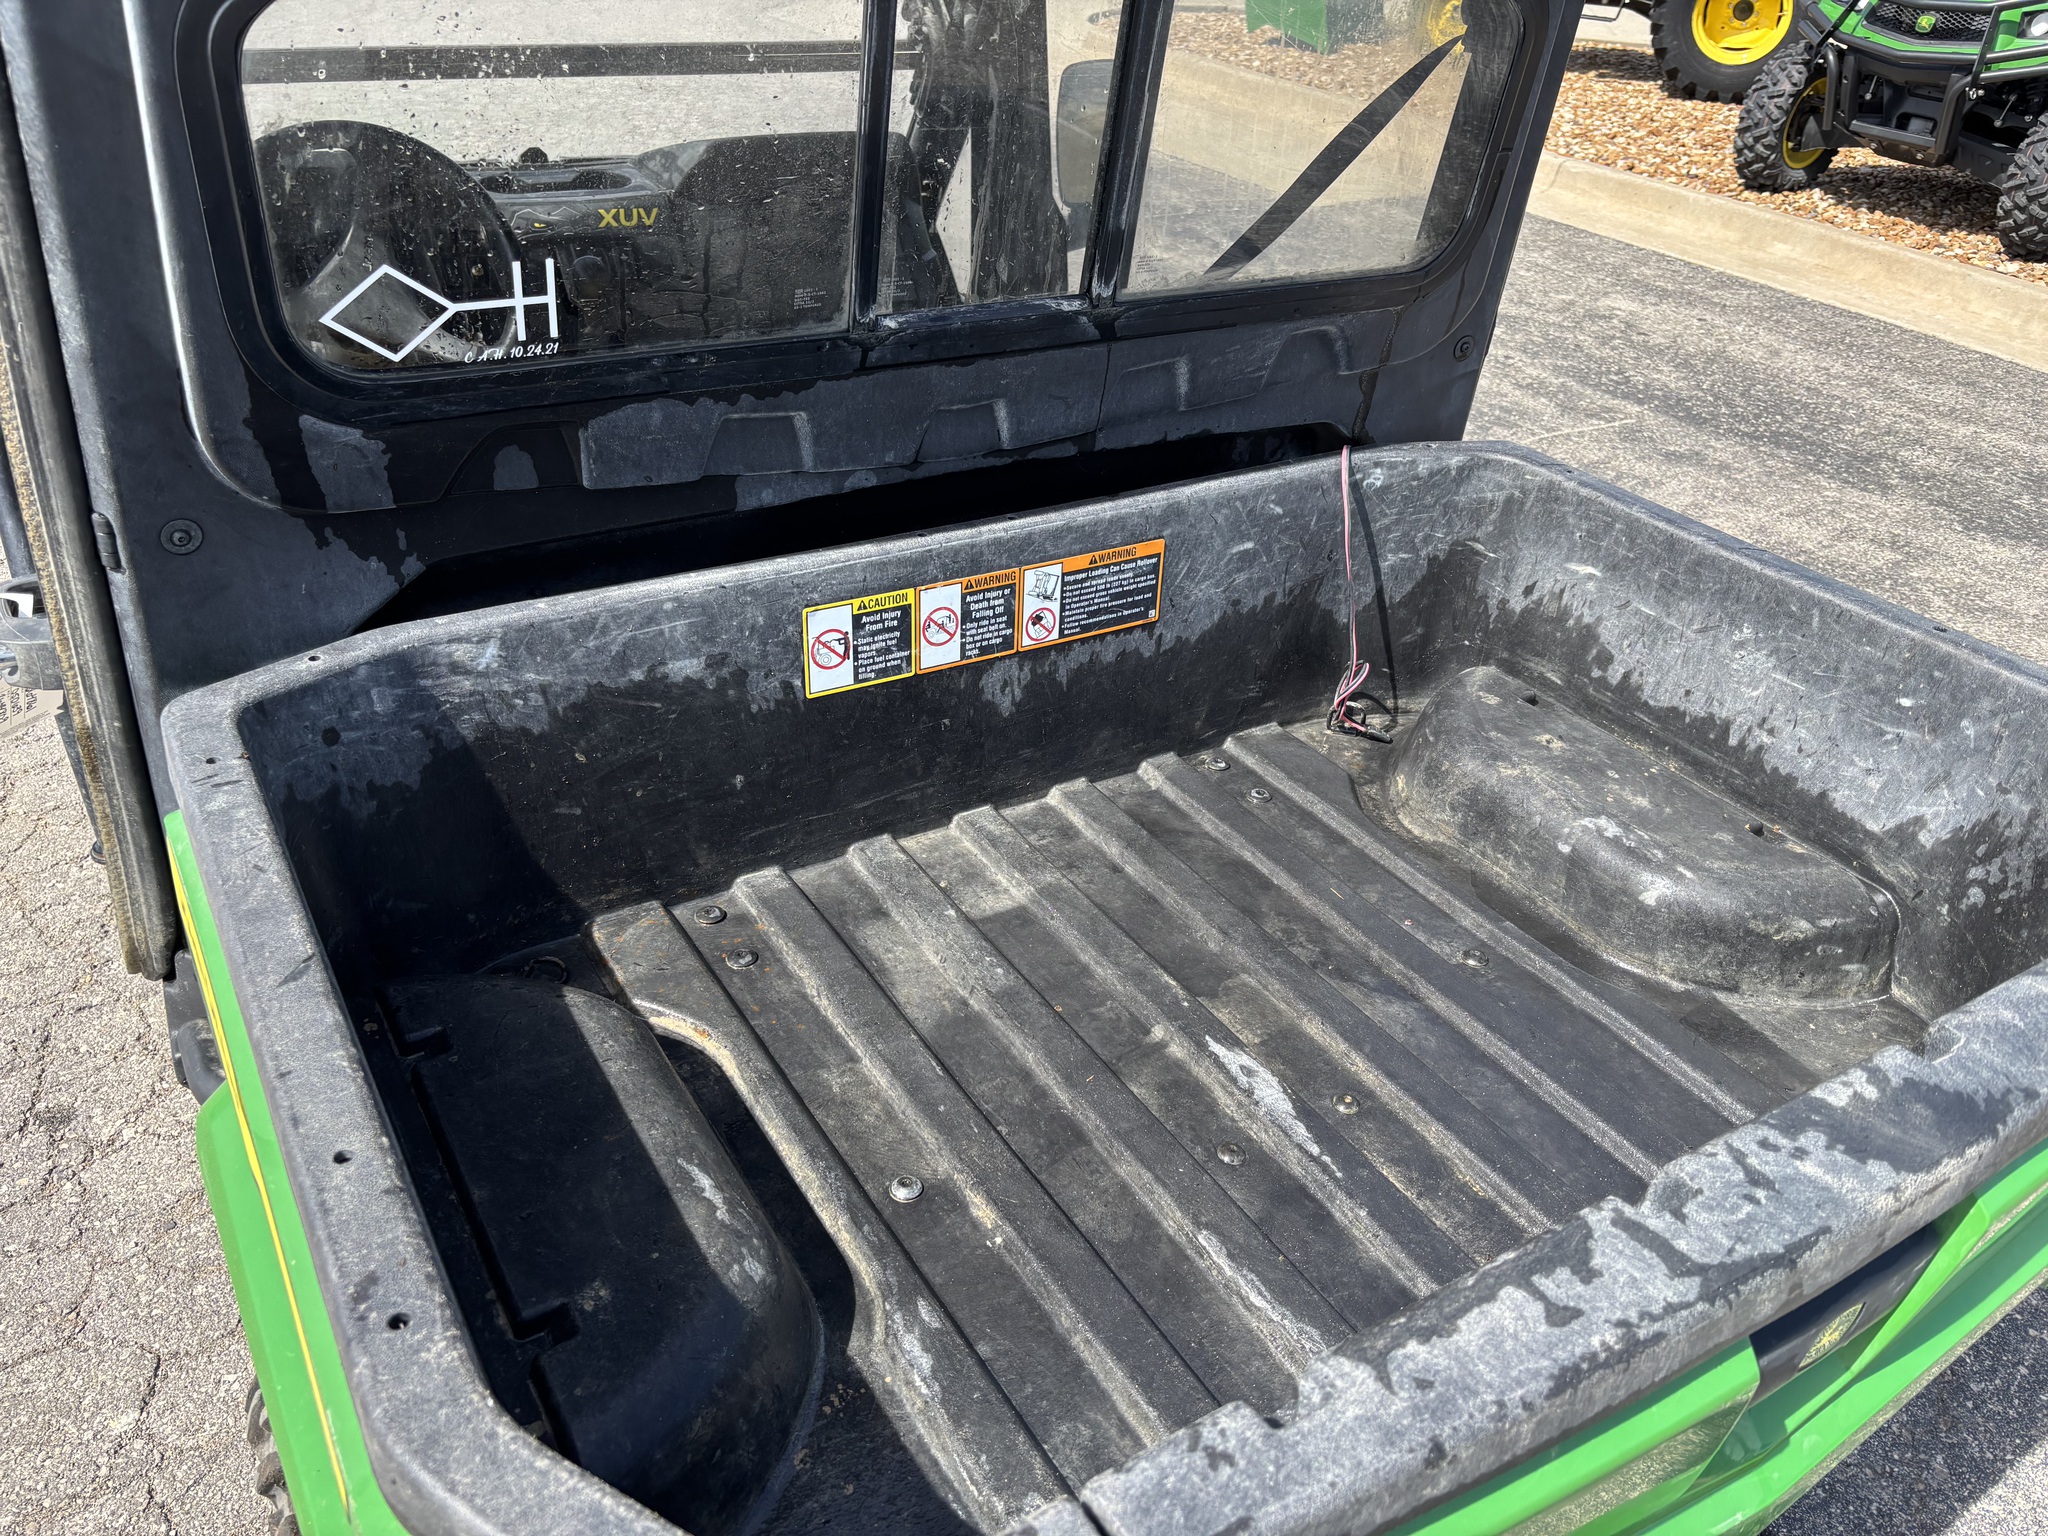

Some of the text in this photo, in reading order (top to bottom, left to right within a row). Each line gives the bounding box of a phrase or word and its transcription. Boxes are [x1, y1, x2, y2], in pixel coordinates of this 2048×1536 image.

[598, 208, 659, 228] XUV
[510, 342, 560, 359] 10.24.21
[1099, 547, 1136, 563] WARNING
[1064, 557, 1158, 582] Improper Loading Can Cause Rollover
[975, 571, 1016, 588] WARNING
[868, 592, 908, 609] CAUTION
[966, 593, 983, 602] Avoid
[985, 590, 1002, 600] Injury
[1071, 598, 1093, 609] Operator's
[1094, 595, 1111, 604] Manual.
[970, 598, 1004, 610] Death from
[861, 610, 901, 623] Avoid Injury
[972, 606, 1004, 618] Falling Off
[1064, 620, 1078, 628] Follow
[1080, 612, 1116, 626] recommendations
[1123, 607, 1144, 617] Operator's
[1065, 614, 1088, 622] conditions.
[866, 619, 898, 631] From Fire
[967, 622, 977, 630] Only
[858, 631, 900, 644] Static electricity
[983, 631, 992, 639] ride
[1000, 628, 1012, 636] cargo
[870, 642, 885, 650] ignite
[887, 638, 897, 646] fuel
[989, 637, 1002, 645] cargo
[858, 651, 877, 659] vapors.
[859, 657, 873, 665] Place
[886, 651, 910, 660] container
[867, 662, 885, 671] ground
[887, 659, 901, 667] when
